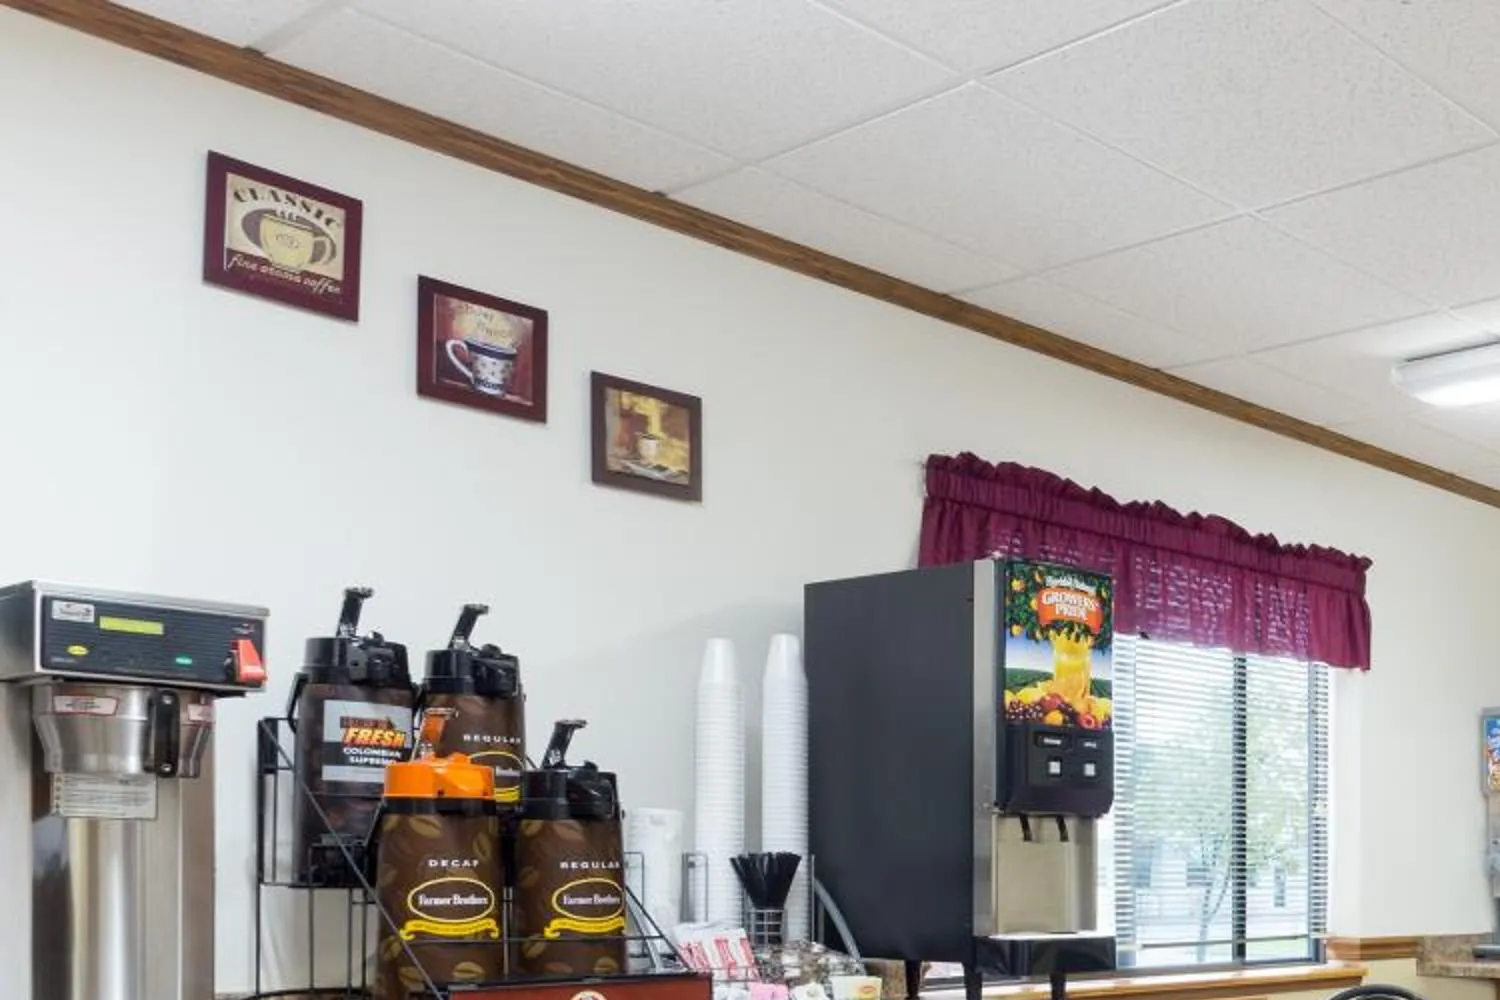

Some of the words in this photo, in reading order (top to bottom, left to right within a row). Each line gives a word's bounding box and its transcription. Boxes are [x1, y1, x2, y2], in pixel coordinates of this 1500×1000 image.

[233, 187, 341, 228] CLASSIC
[343, 727, 408, 750] FRESH
[427, 858, 480, 868] DECAF
